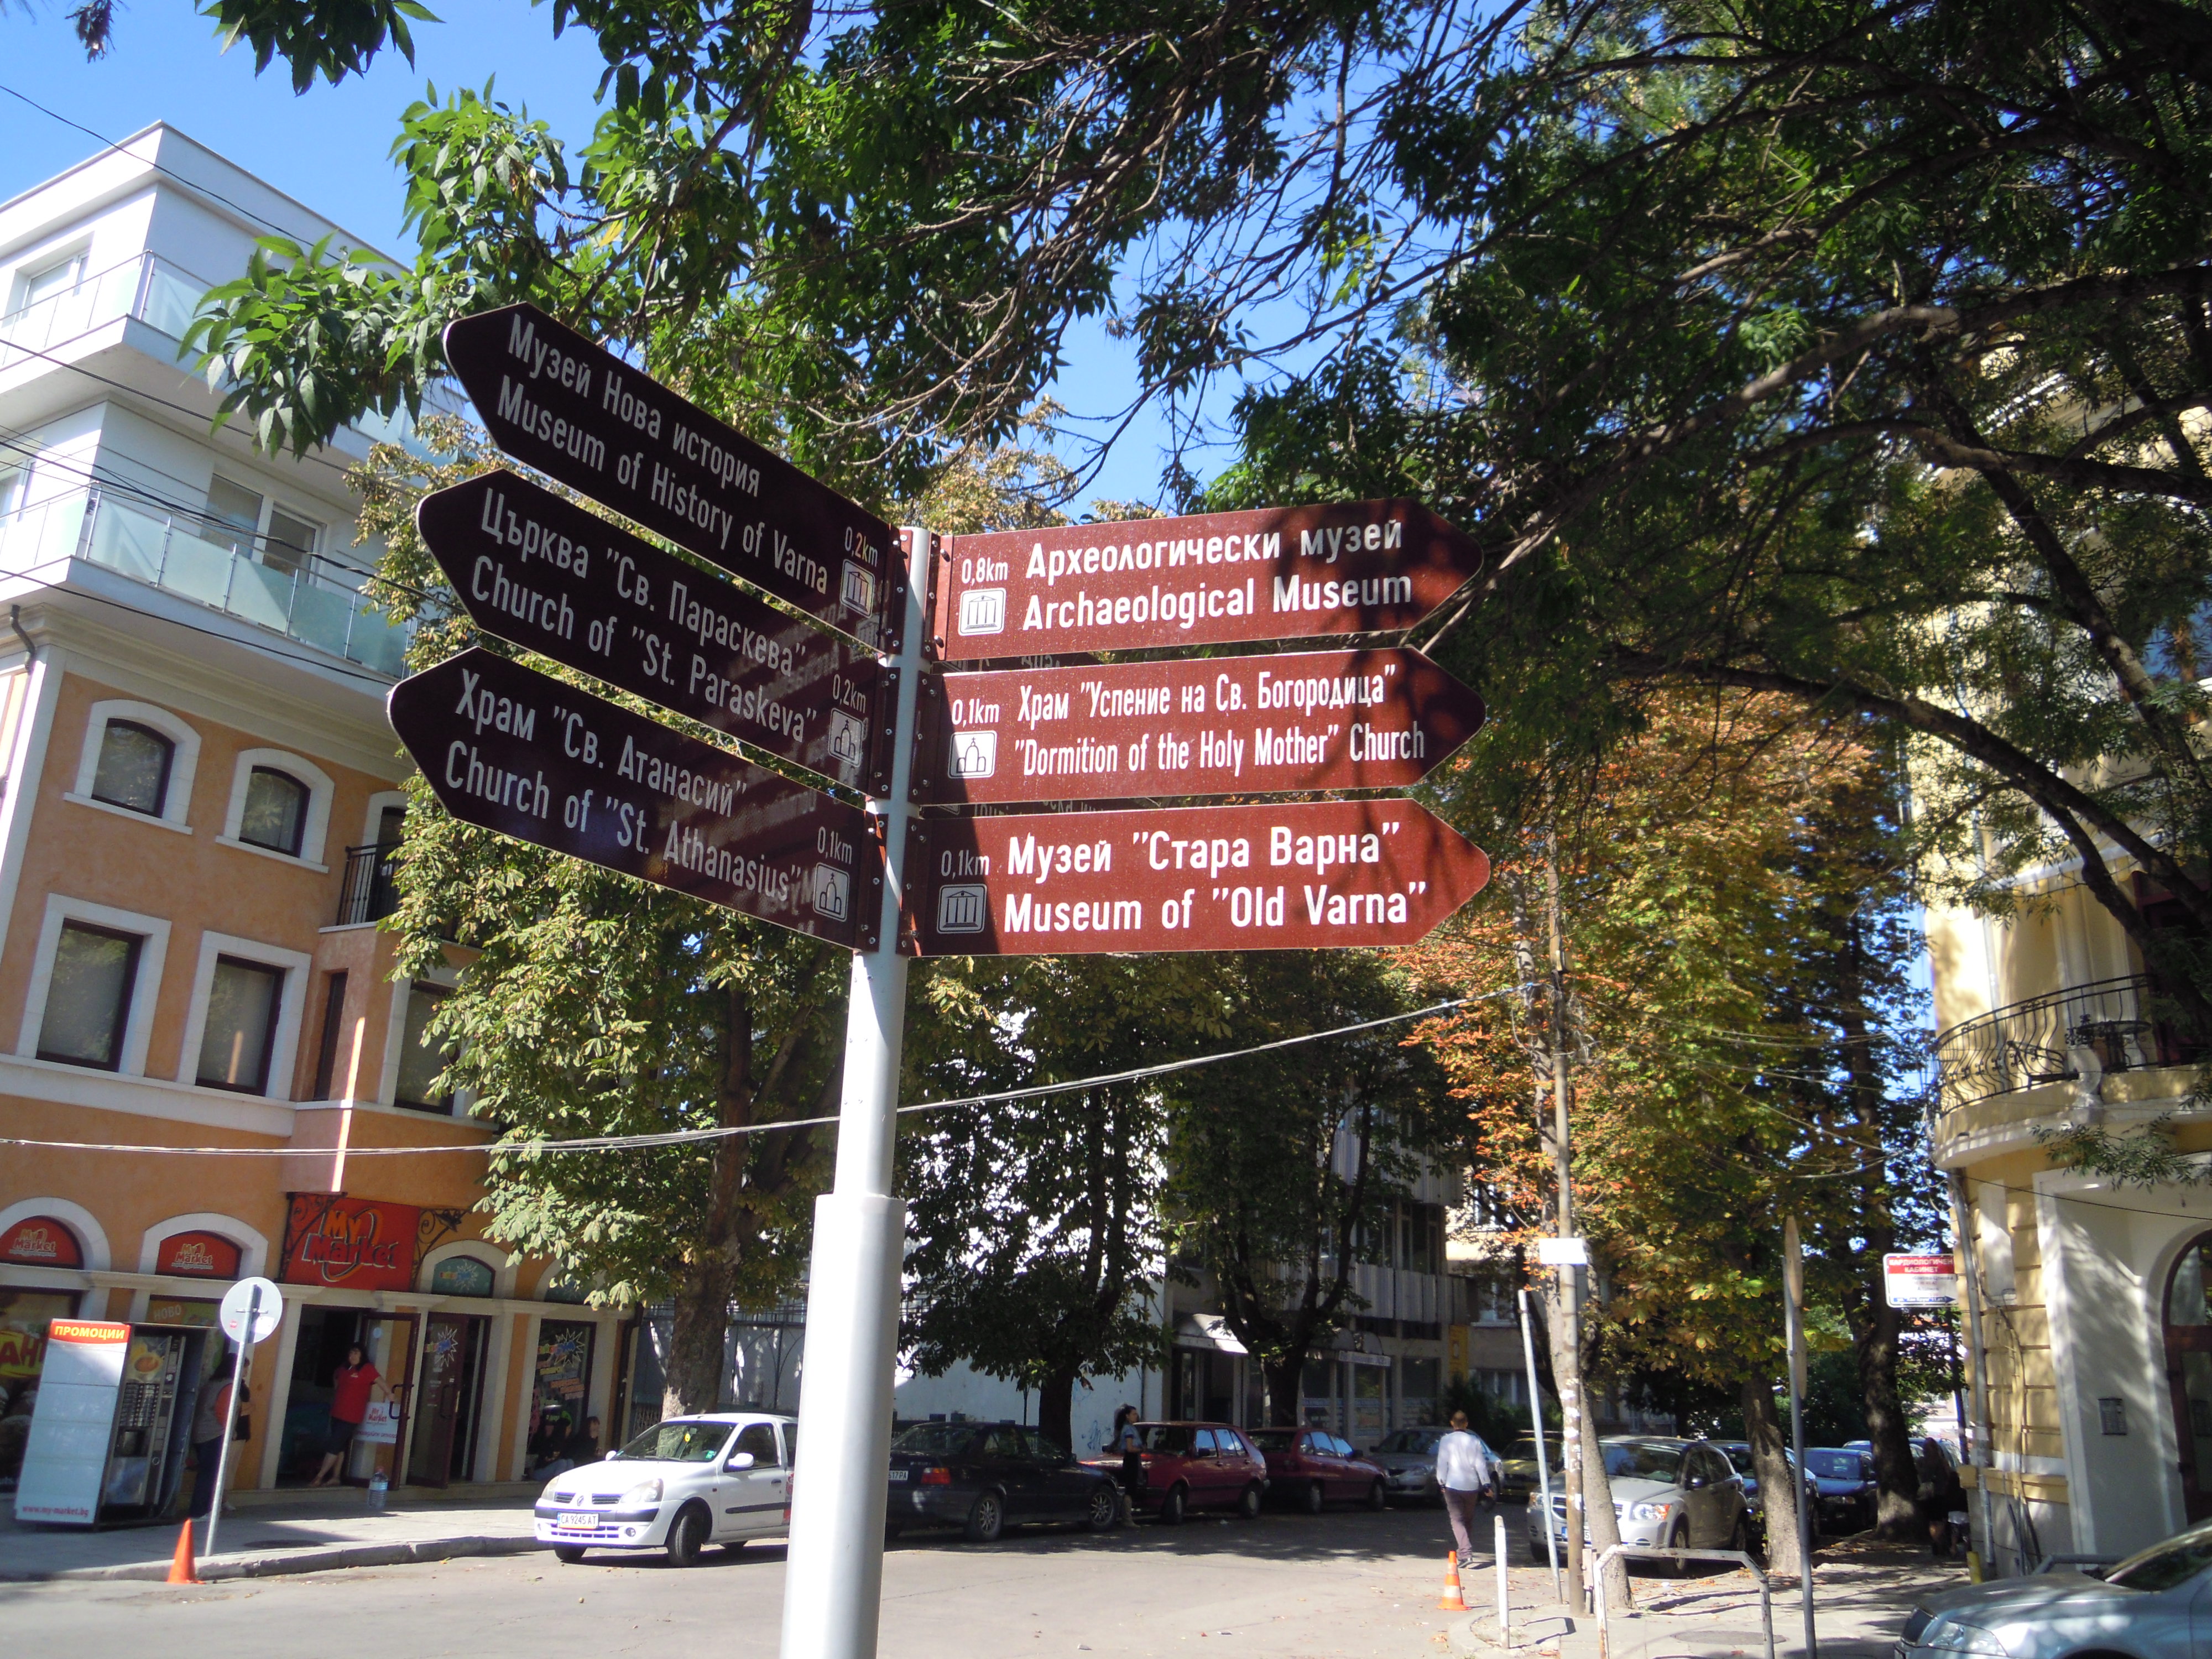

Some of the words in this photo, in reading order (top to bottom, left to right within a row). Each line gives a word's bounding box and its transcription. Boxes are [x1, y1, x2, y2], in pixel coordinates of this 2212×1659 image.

[508, 313, 591, 398] Музей
[603, 369, 661, 440] Нова
[674, 422, 760, 497] история
[498, 374, 605, 471] Museum
[617, 451, 644, 491] of
[651, 461, 733, 550] History
[743, 521, 766, 559] of
[773, 529, 827, 594] Varna
[844, 526, 879, 567] 0,2km
[1025, 531, 1281, 587] Археологически
[1300, 519, 1403, 564] музей
[481, 488, 588, 579] Църква
[607, 547, 654, 611] "Св.
[669, 581, 806, 676] Параскева"
[962, 558, 1008, 585] 0,8km
[1022, 578, 1255, 631] Archaeological
[1273, 573, 1412, 613] Museum
[472, 555, 573, 640] Church
[588, 616, 617, 656] of
[632, 626, 675, 685] "St.
[689, 654, 817, 743] Paraskeva"
[832, 674, 866, 713] 0,2km
[951, 698, 999, 726] 0,1km
[1017, 685, 1070, 731] Храм
[1081, 681, 1171, 720] "Успение
[1182, 685, 1206, 713] на
[1215, 674, 1248, 712] Св.
[1258, 665, 1396, 717] Богородица"
[455, 667, 536, 742] Храм
[554, 706, 603, 769] "Св.
[618, 735, 746, 818] Атанасий"
[1015, 738, 1118, 777] "Dormition
[1128, 733, 1150, 772] of
[1157, 733, 1190, 771] the
[1199, 730, 1245, 777] Holy
[1255, 724, 1338, 767] Mother"
[1349, 721, 1425, 763] Church
[445, 740, 549, 820] Church
[564, 789, 593, 832] of
[606, 796, 650, 855] "St.
[663, 820, 801, 902] Athanasius"
[817, 826, 852, 865] 0,1km
[941, 850, 989, 879] 0,1km
[1007, 835, 1112, 884] Музей
[1133, 830, 1250, 879] "Стара
[1270, 822, 1401, 875] Варна"
[1004, 893, 1142, 933] Museum
[1161, 888, 1194, 930] of
[1212, 885, 1285, 927] "Old
[1305, 881, 1427, 926] Varna"
[13, 1238, 56, 1251] Market
[319, 1209, 361, 1244] My
[174, 1252, 212, 1265] Market
[302, 1234, 398, 1269] Market
[55, 1326, 125, 1340] ПРОМОЦИИ
[154, 1305, 181, 1321] НОВО
[23, 1506, 88, 1517] www.my-market.bg
[561, 1515, 569, 1524] CA
[571, 1515, 586, 1525] 9245
[588, 1516, 597, 1525] AT
